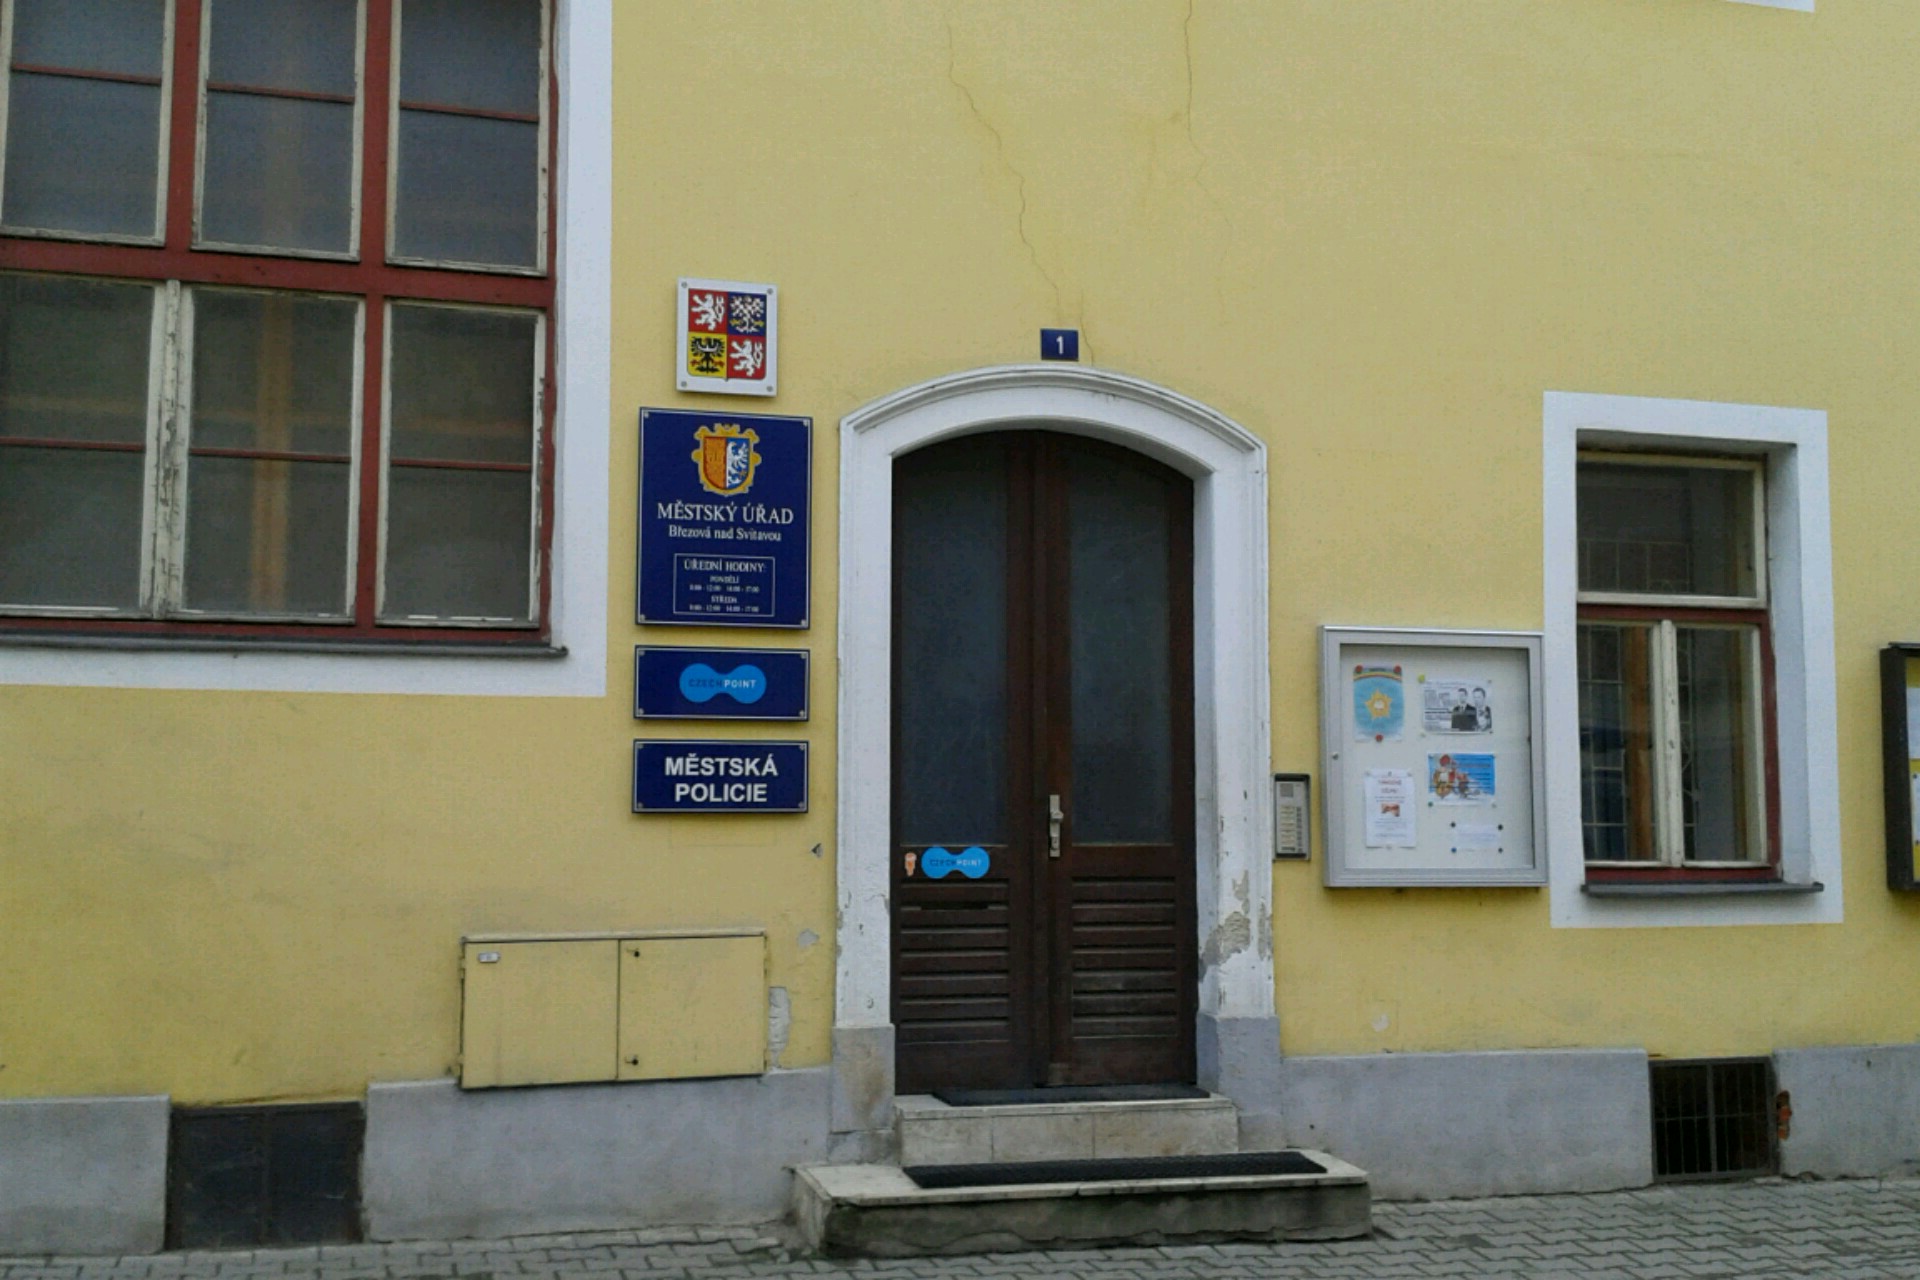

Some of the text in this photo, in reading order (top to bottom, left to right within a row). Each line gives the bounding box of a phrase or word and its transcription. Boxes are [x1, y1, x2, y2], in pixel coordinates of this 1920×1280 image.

[1056, 336, 1065, 354] 1
[657, 499, 794, 524] MĚSTSKÝ ÚŘAD
[668, 524, 782, 541] Březová nad Svitavou
[664, 753, 778, 777] MĚSTSKÁ
[674, 783, 767, 803] POLICIE
